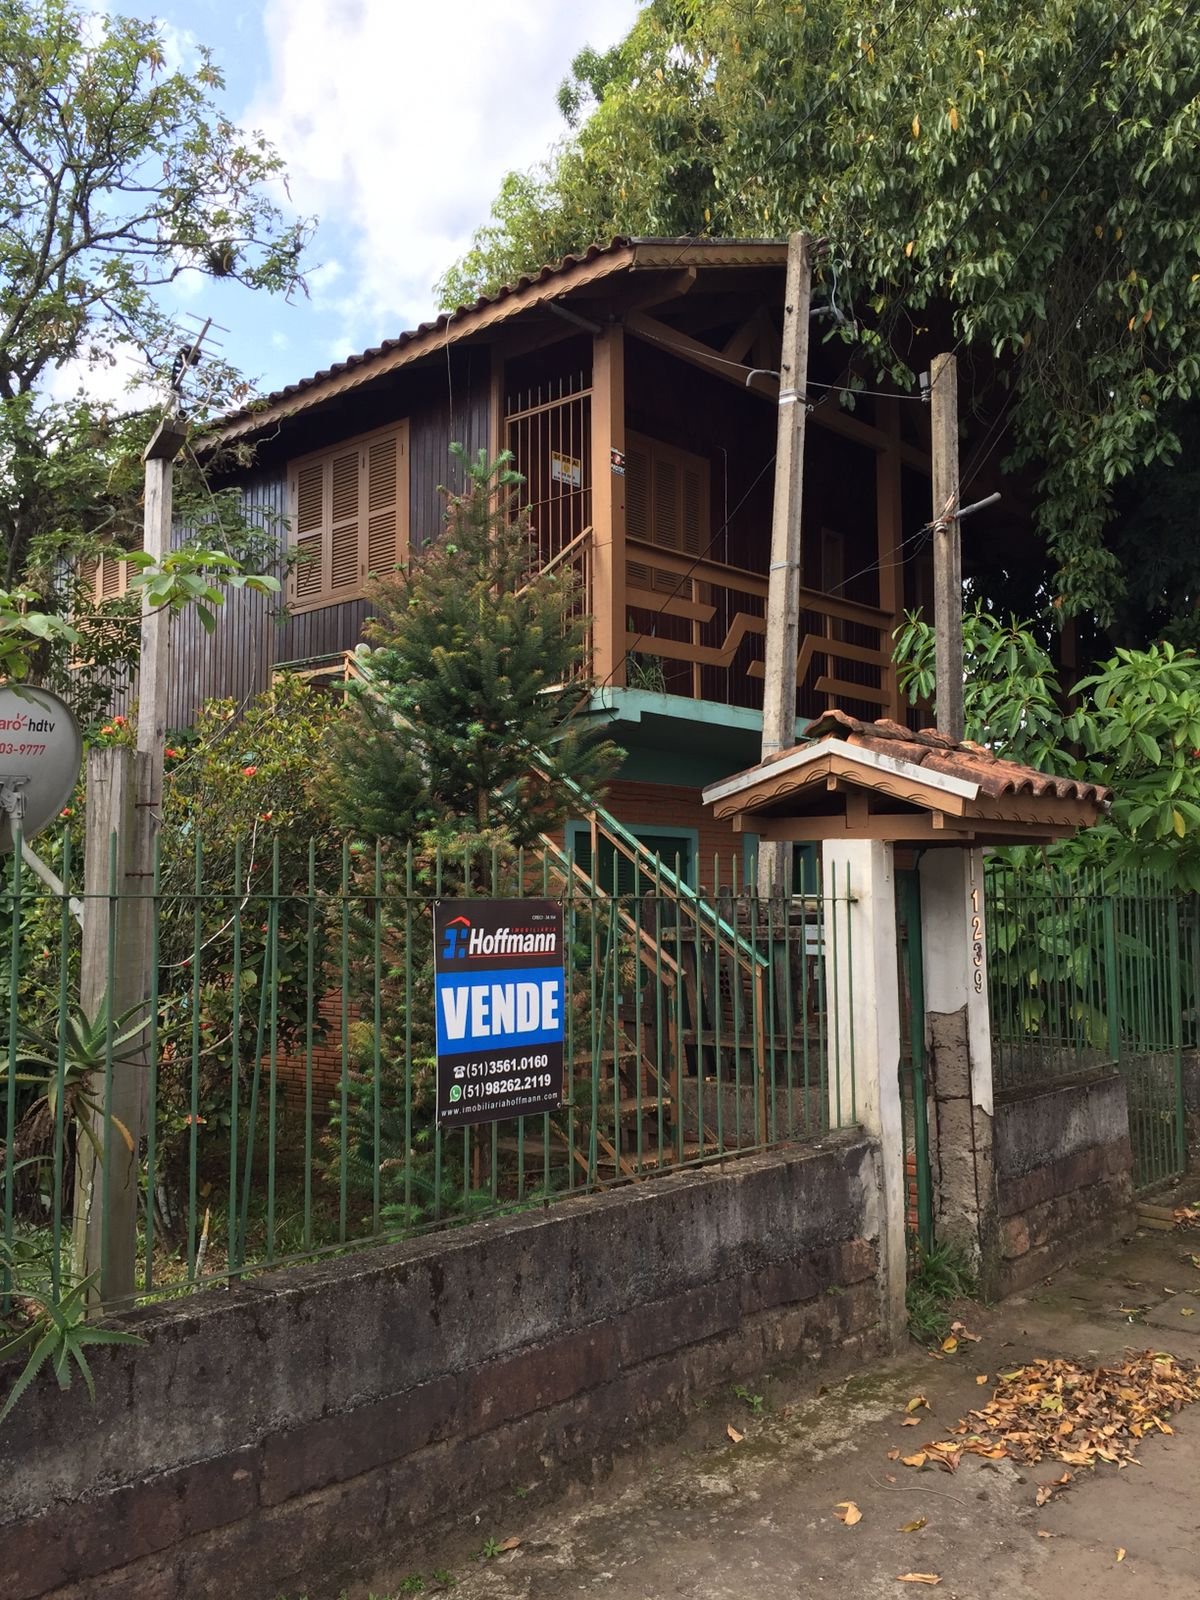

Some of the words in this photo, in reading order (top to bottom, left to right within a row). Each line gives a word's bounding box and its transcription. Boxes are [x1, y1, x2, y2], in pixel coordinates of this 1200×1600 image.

[469, 928, 556, 955] Hoffmann
[971, 888, 983, 994] 1239
[441, 981, 559, 1040] VENDE
[466, 1054, 548, 1078] (51)3561.0160
[462, 1073, 551, 1100] (51)98262.2119
[441, 1092, 558, 1116] www.imobiliariahoffmann.com
